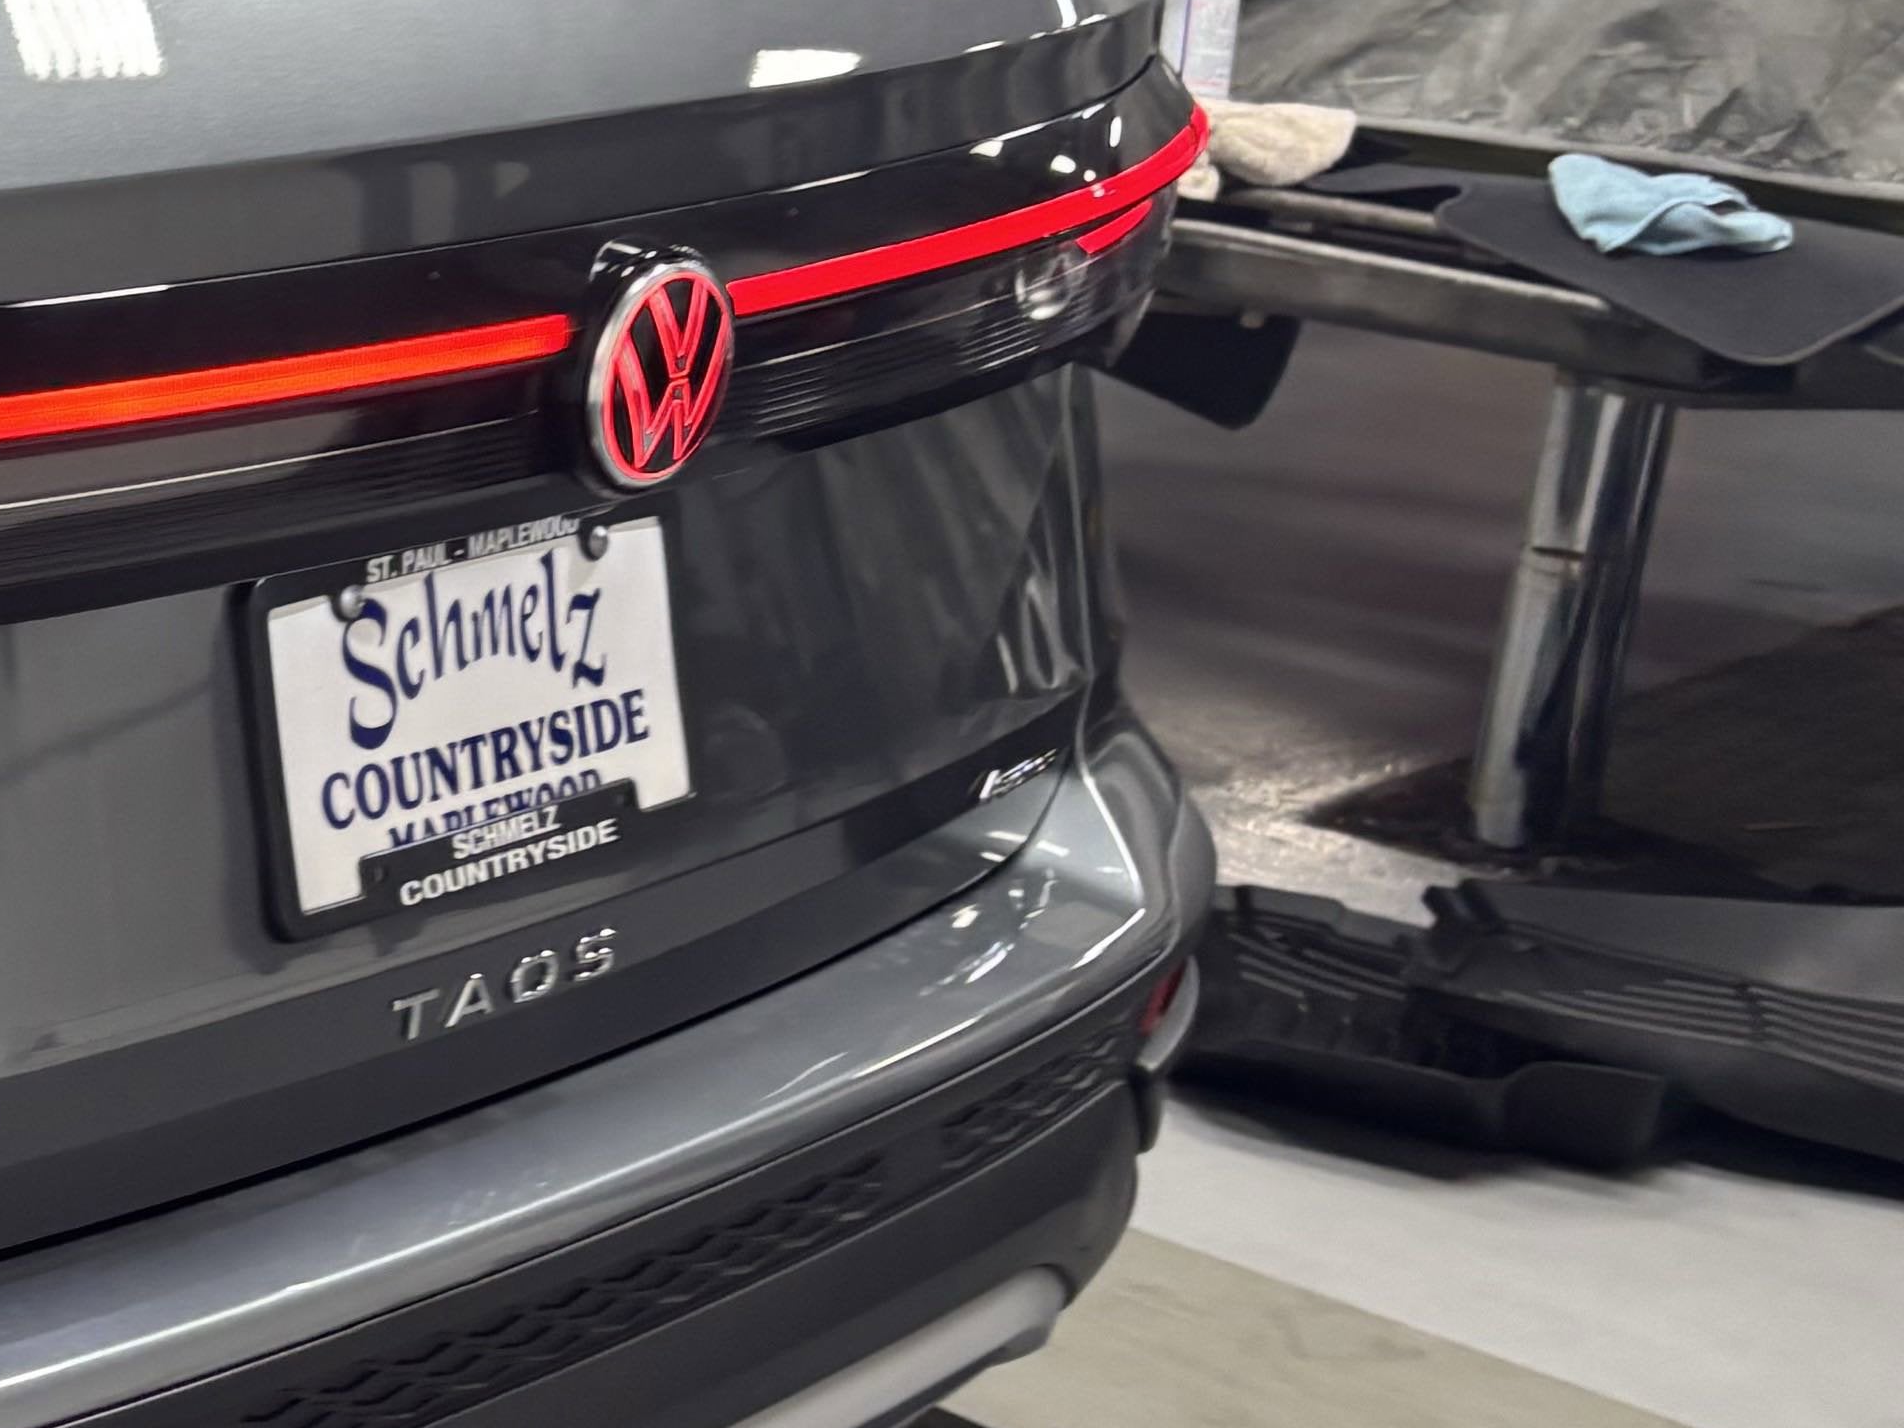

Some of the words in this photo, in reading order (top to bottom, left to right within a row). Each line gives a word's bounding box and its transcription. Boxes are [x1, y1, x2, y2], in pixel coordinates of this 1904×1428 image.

[366, 554, 397, 584] ST.
[401, 543, 452, 573] PAUL
[342, 549, 607, 750] Schmelz
[322, 688, 650, 831] COUNTRYSIDE
[399, 817, 621, 907] COUNTRYSIDE
[452, 805, 563, 860] SCHMELZ
[392, 928, 617, 1041] TAOS
